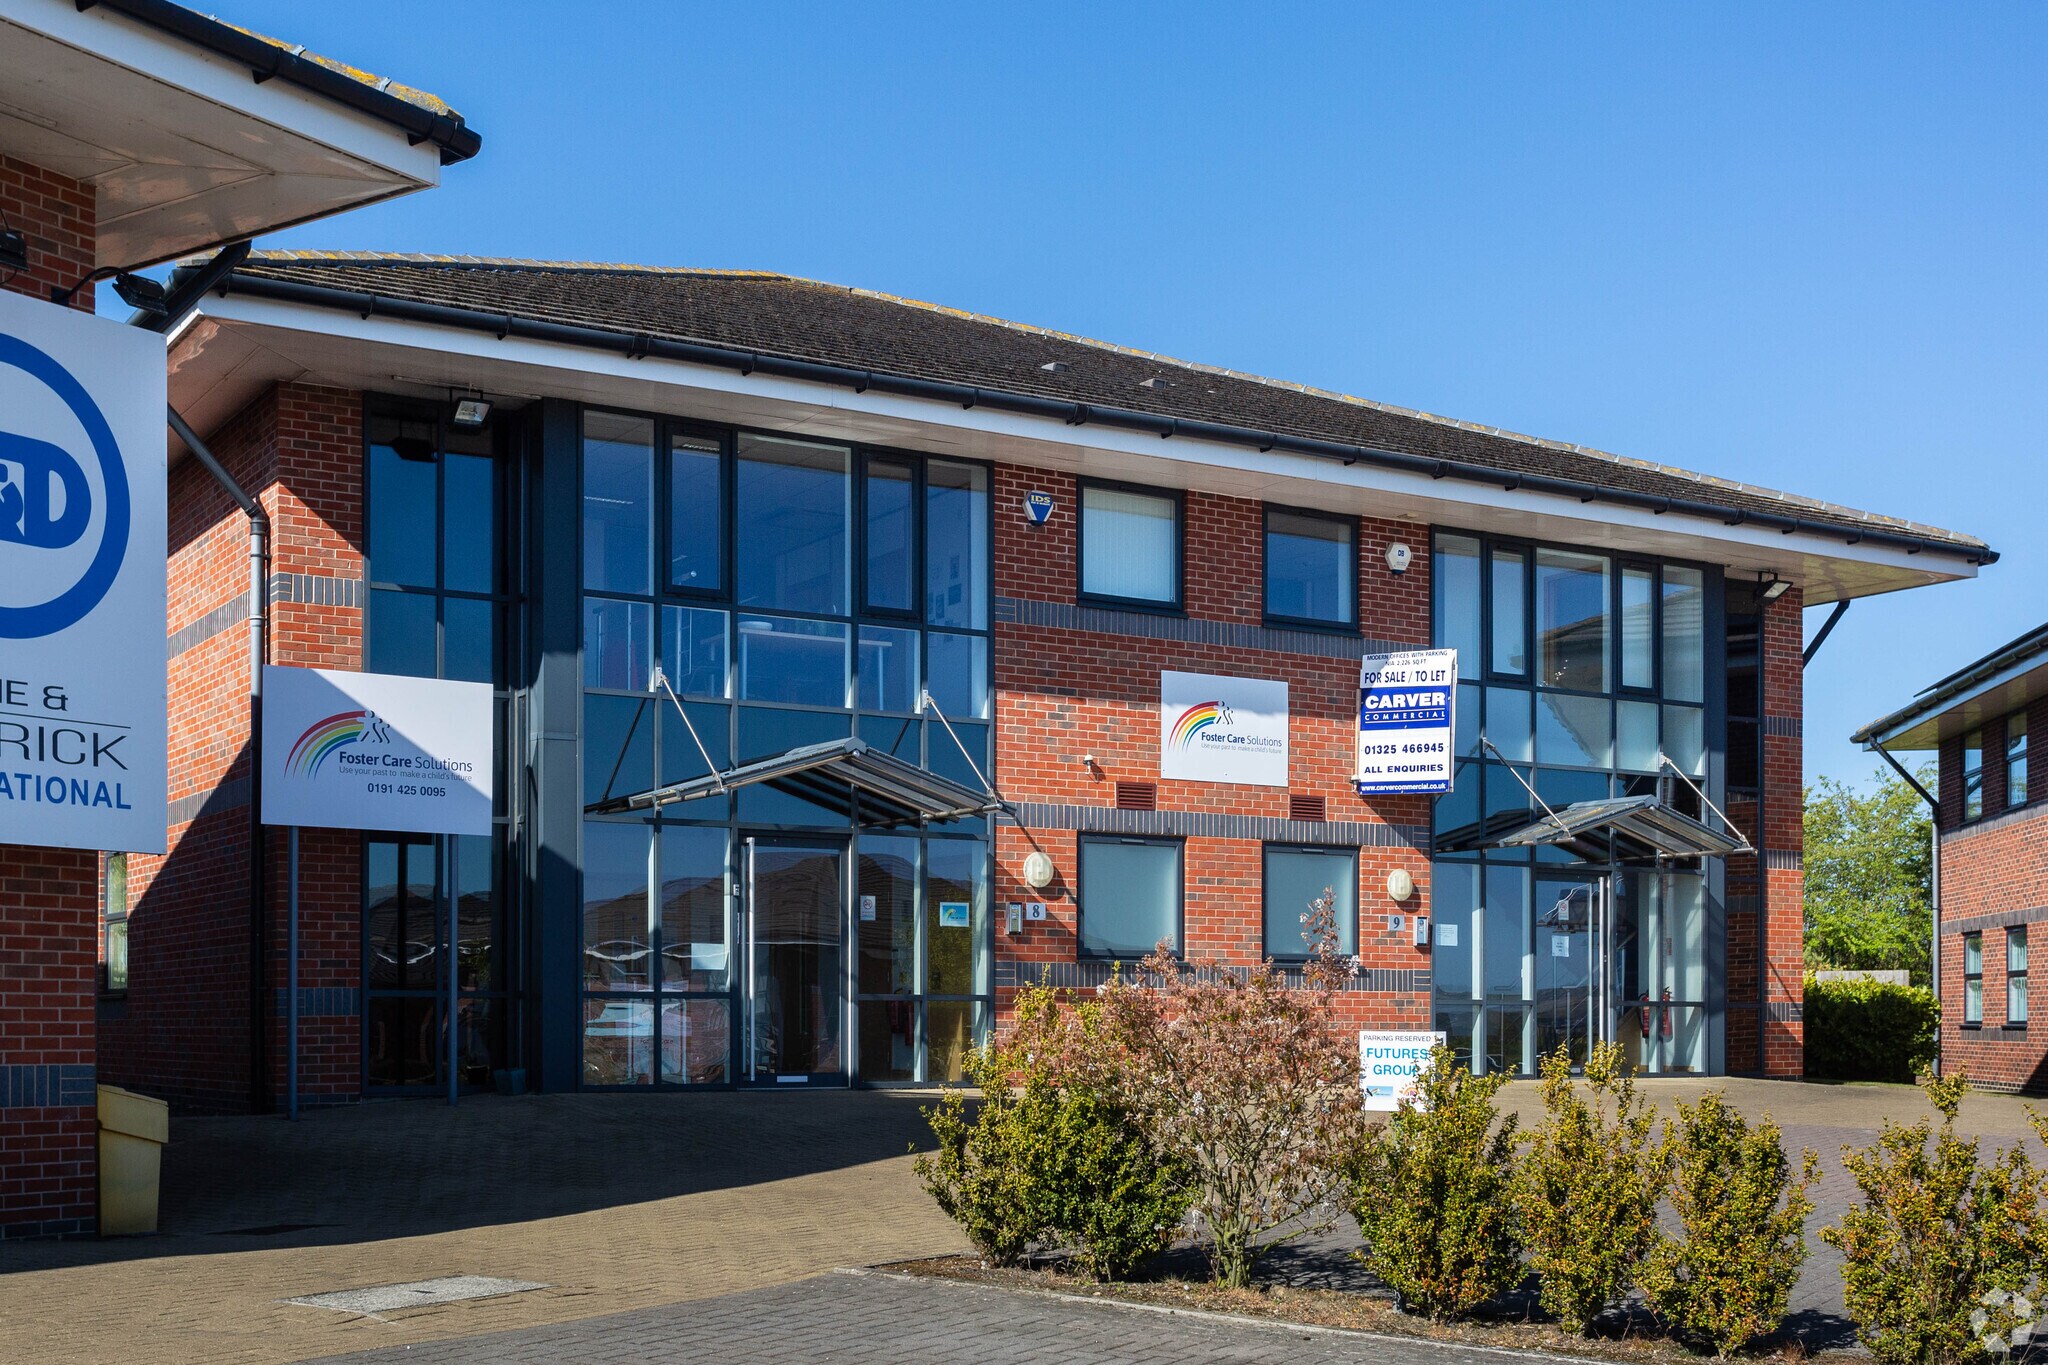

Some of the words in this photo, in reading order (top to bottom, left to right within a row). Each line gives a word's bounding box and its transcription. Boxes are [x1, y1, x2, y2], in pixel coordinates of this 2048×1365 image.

[1031, 495, 1050, 503] IDS
[1364, 672, 1382, 684] FOR
[1384, 671, 1406, 683] SALE
[1407, 671, 1413, 683] /
[1415, 670, 1428, 682] TO
[1430, 670, 1446, 681] LET
[43, 685, 68, 712] &
[1365, 692, 1446, 709] CARVER
[1364, 711, 1446, 721] COMMERCIAL
[1201, 732, 1225, 742] Foster
[1227, 734, 1245, 744] Care
[1246, 735, 1282, 747] Solutions
[1364, 745, 1397, 755] 01325
[1402, 743, 1444, 753] 466945
[339, 751, 380, 766] Foster
[382, 753, 412, 768] Care
[414, 756, 473, 772] Solutions
[339, 766, 354, 774] Use
[354, 767, 371, 777] your
[372, 768, 388, 778] past
[388, 769, 397, 777] to
[400, 769, 421, 779] make
[427, 771, 450, 780] child's
[450, 772, 473, 782] future
[1364, 766, 1383, 774] ALL
[1387, 764, 1444, 773] ENQUIRIES
[367, 783, 393, 794] 0191
[397, 784, 417, 795] 425
[419, 785, 446, 797] 0095
[1361, 782, 1447, 791] www.carvercommercial.co.uk
[1032, 904, 1040, 918] 8
[1393, 916, 1400, 929] 9
[1367, 1048, 1428, 1060] FUTURES
